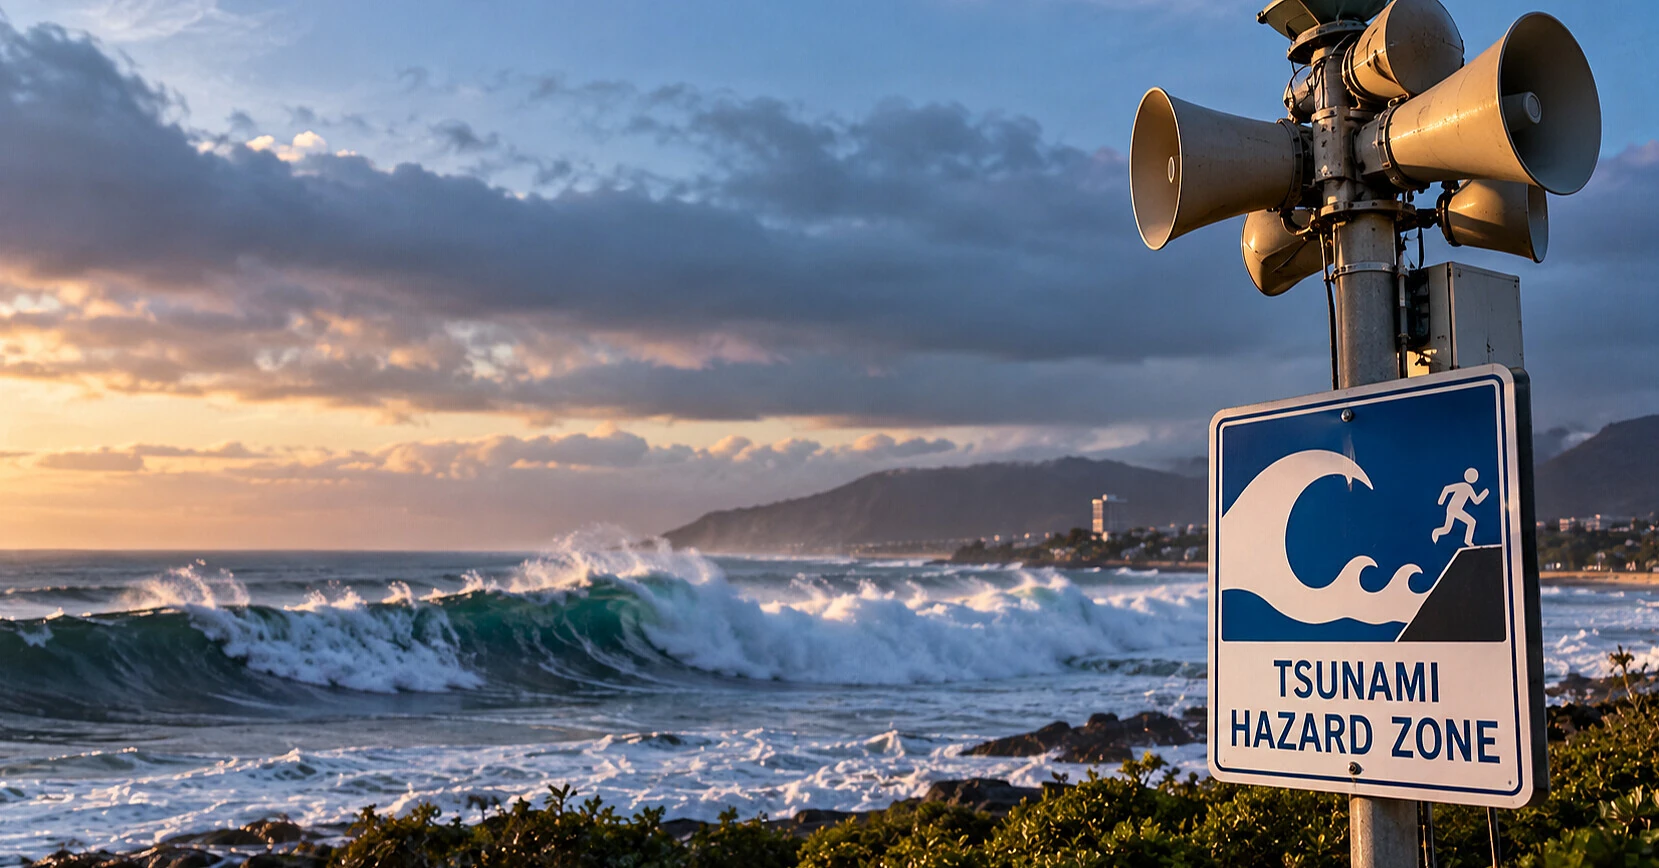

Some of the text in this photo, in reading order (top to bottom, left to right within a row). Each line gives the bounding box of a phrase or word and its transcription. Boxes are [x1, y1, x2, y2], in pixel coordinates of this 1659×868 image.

[1274, 659, 1440, 703] TSUNAMI
[1231, 709, 1501, 764] HAZARD ZONE
